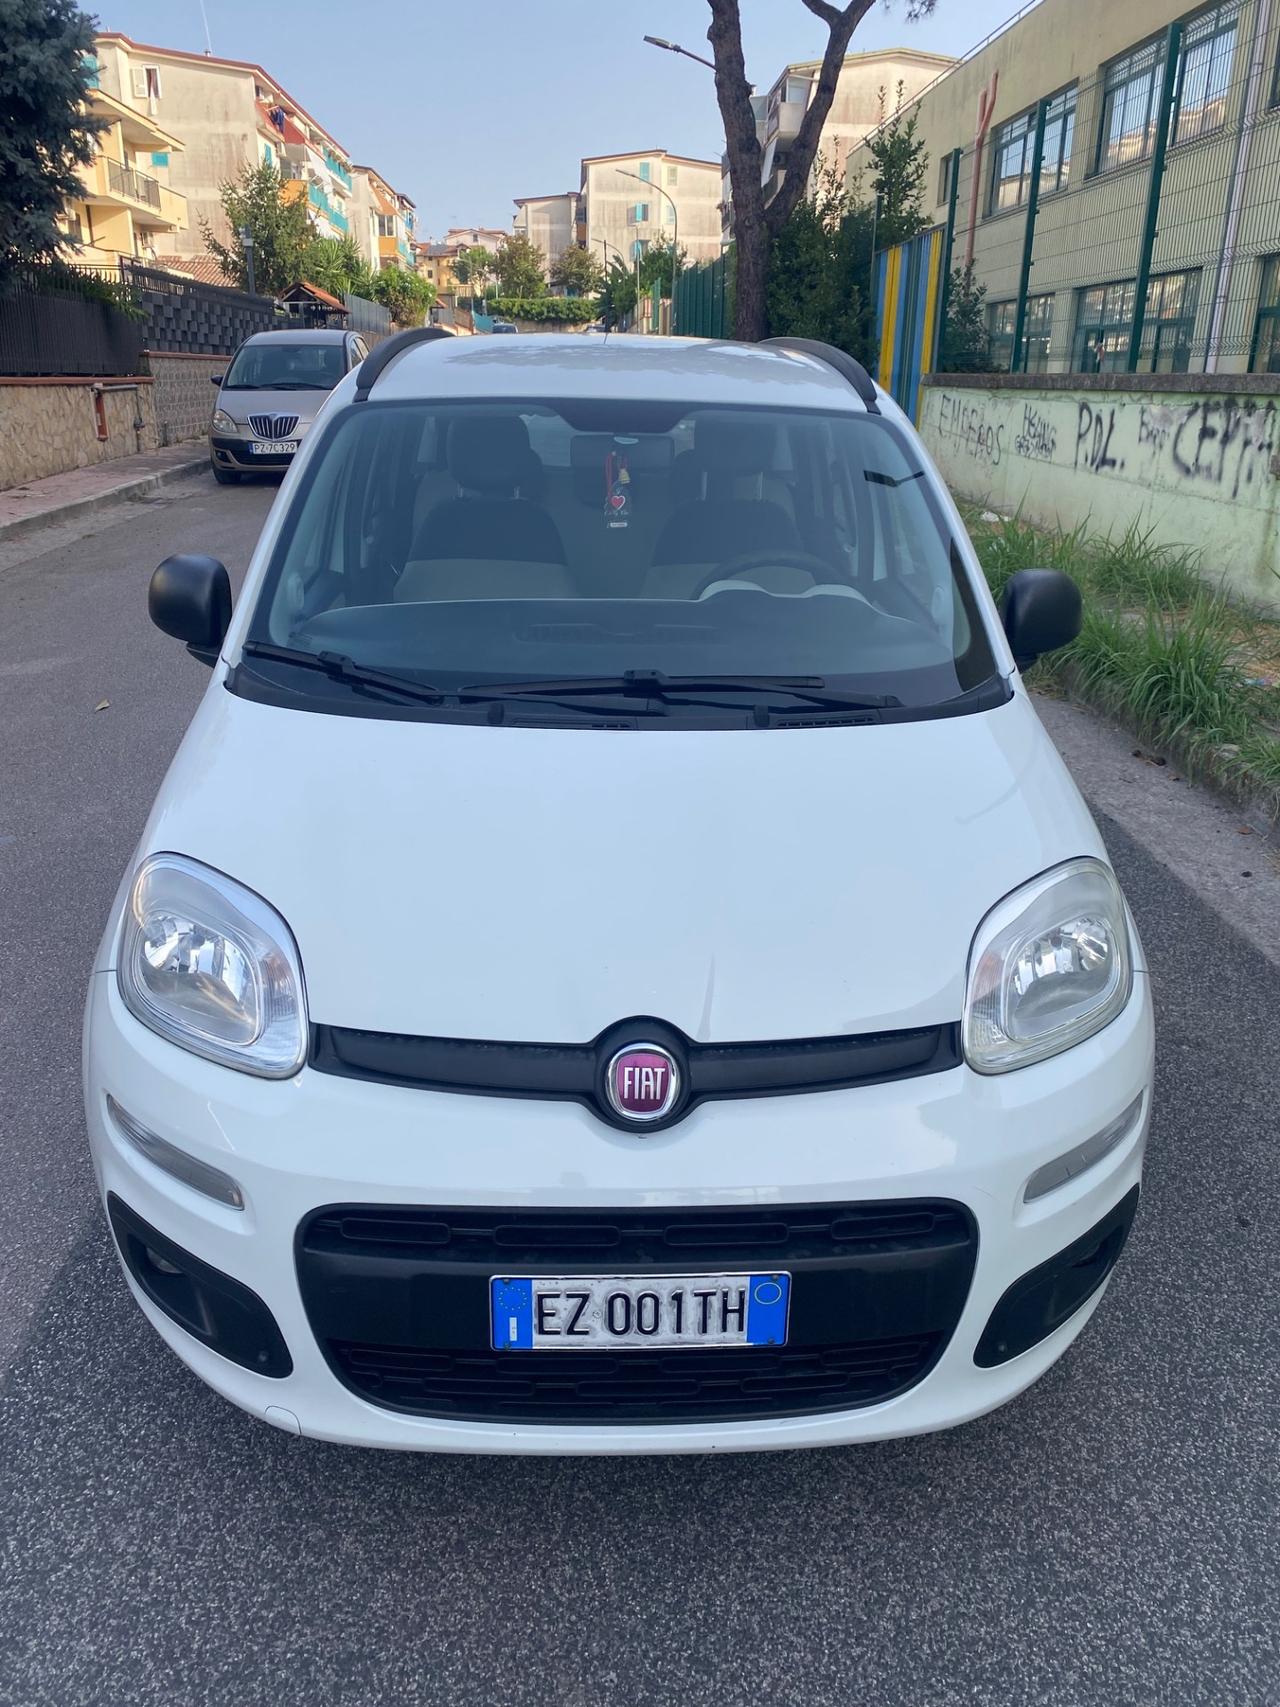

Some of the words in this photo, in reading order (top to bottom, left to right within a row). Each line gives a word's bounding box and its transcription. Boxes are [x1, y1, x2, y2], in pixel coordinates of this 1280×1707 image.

[254, 444, 266, 453] PZ
[623, 1066, 666, 1100] FIAT
[536, 1291, 590, 1335] EZ
[606, 1288, 746, 1335] 001TH
